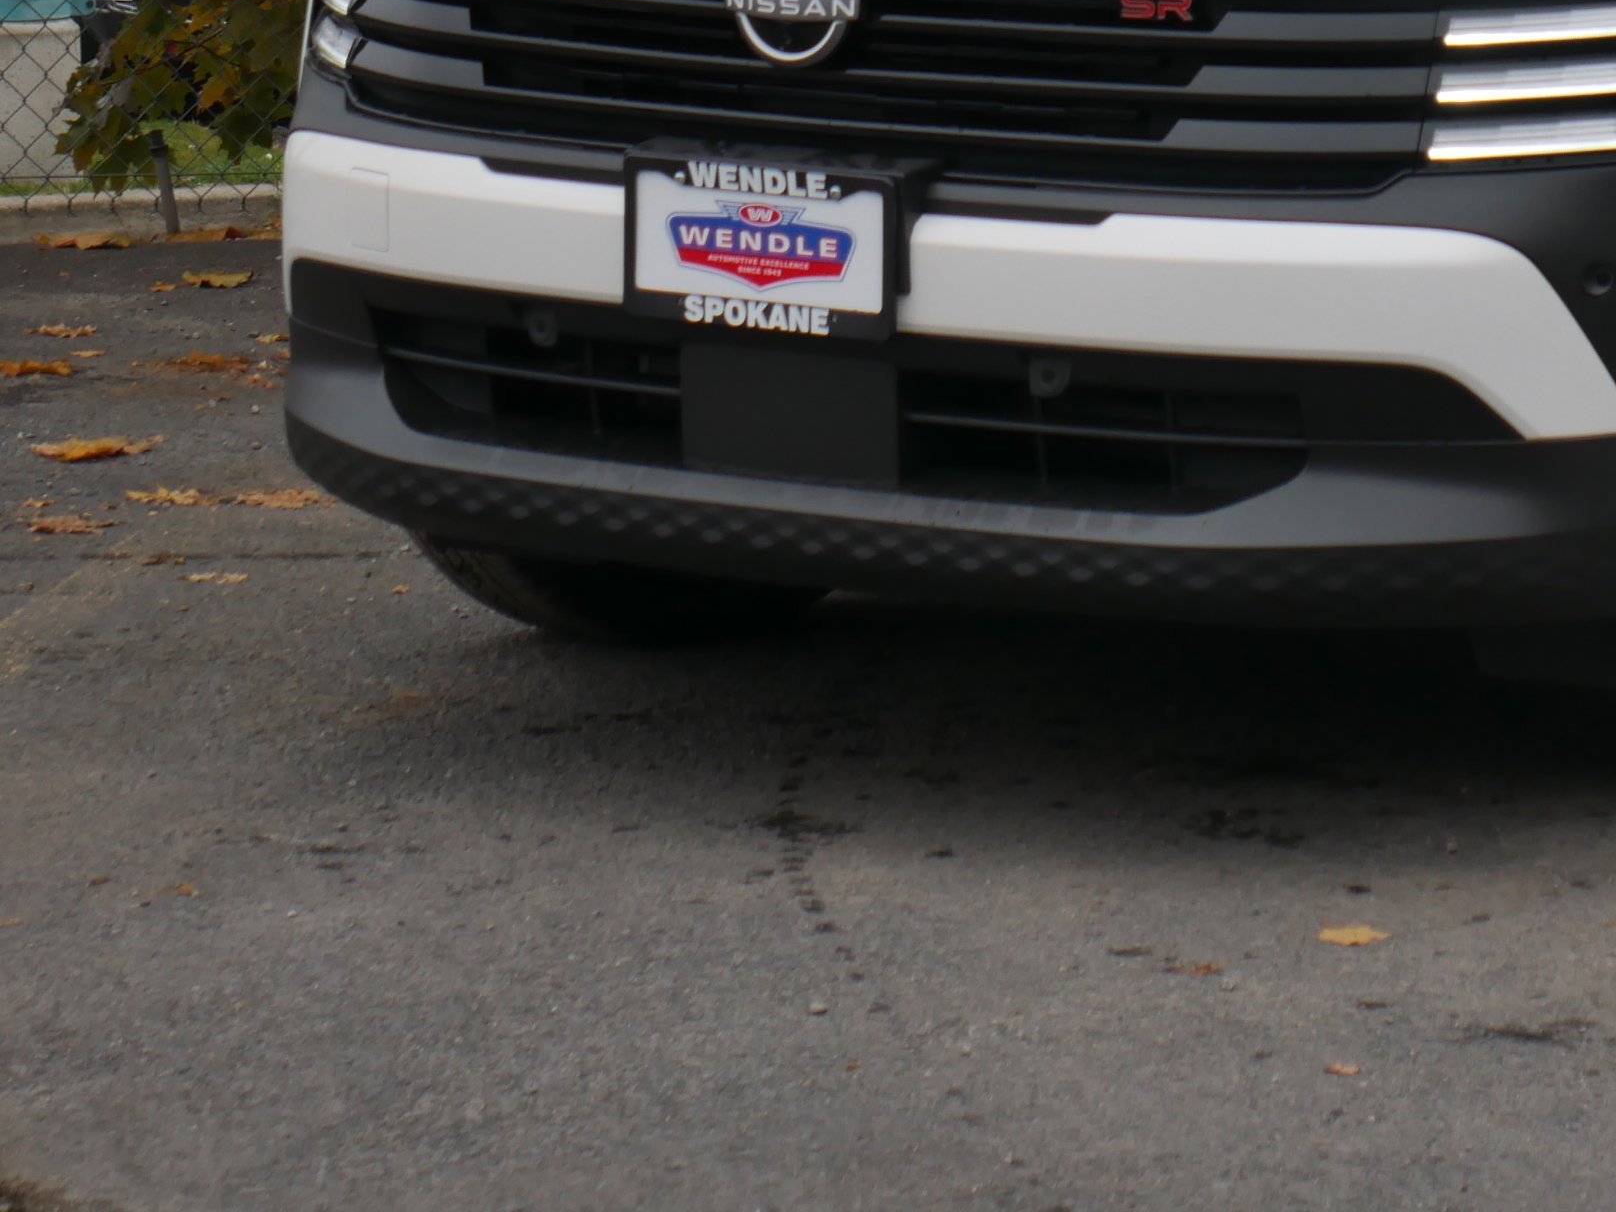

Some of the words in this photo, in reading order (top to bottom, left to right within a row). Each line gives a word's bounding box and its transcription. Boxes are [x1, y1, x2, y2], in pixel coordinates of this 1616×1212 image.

[687, 161, 829, 199] WENDLE
[678, 224, 838, 259] WENDLE
[707, 253, 759, 266] AUTOMOTIVE
[760, 258, 810, 271] EXCELLENCE
[737, 265, 762, 276] SINCE
[683, 294, 830, 335] SPOKANE
